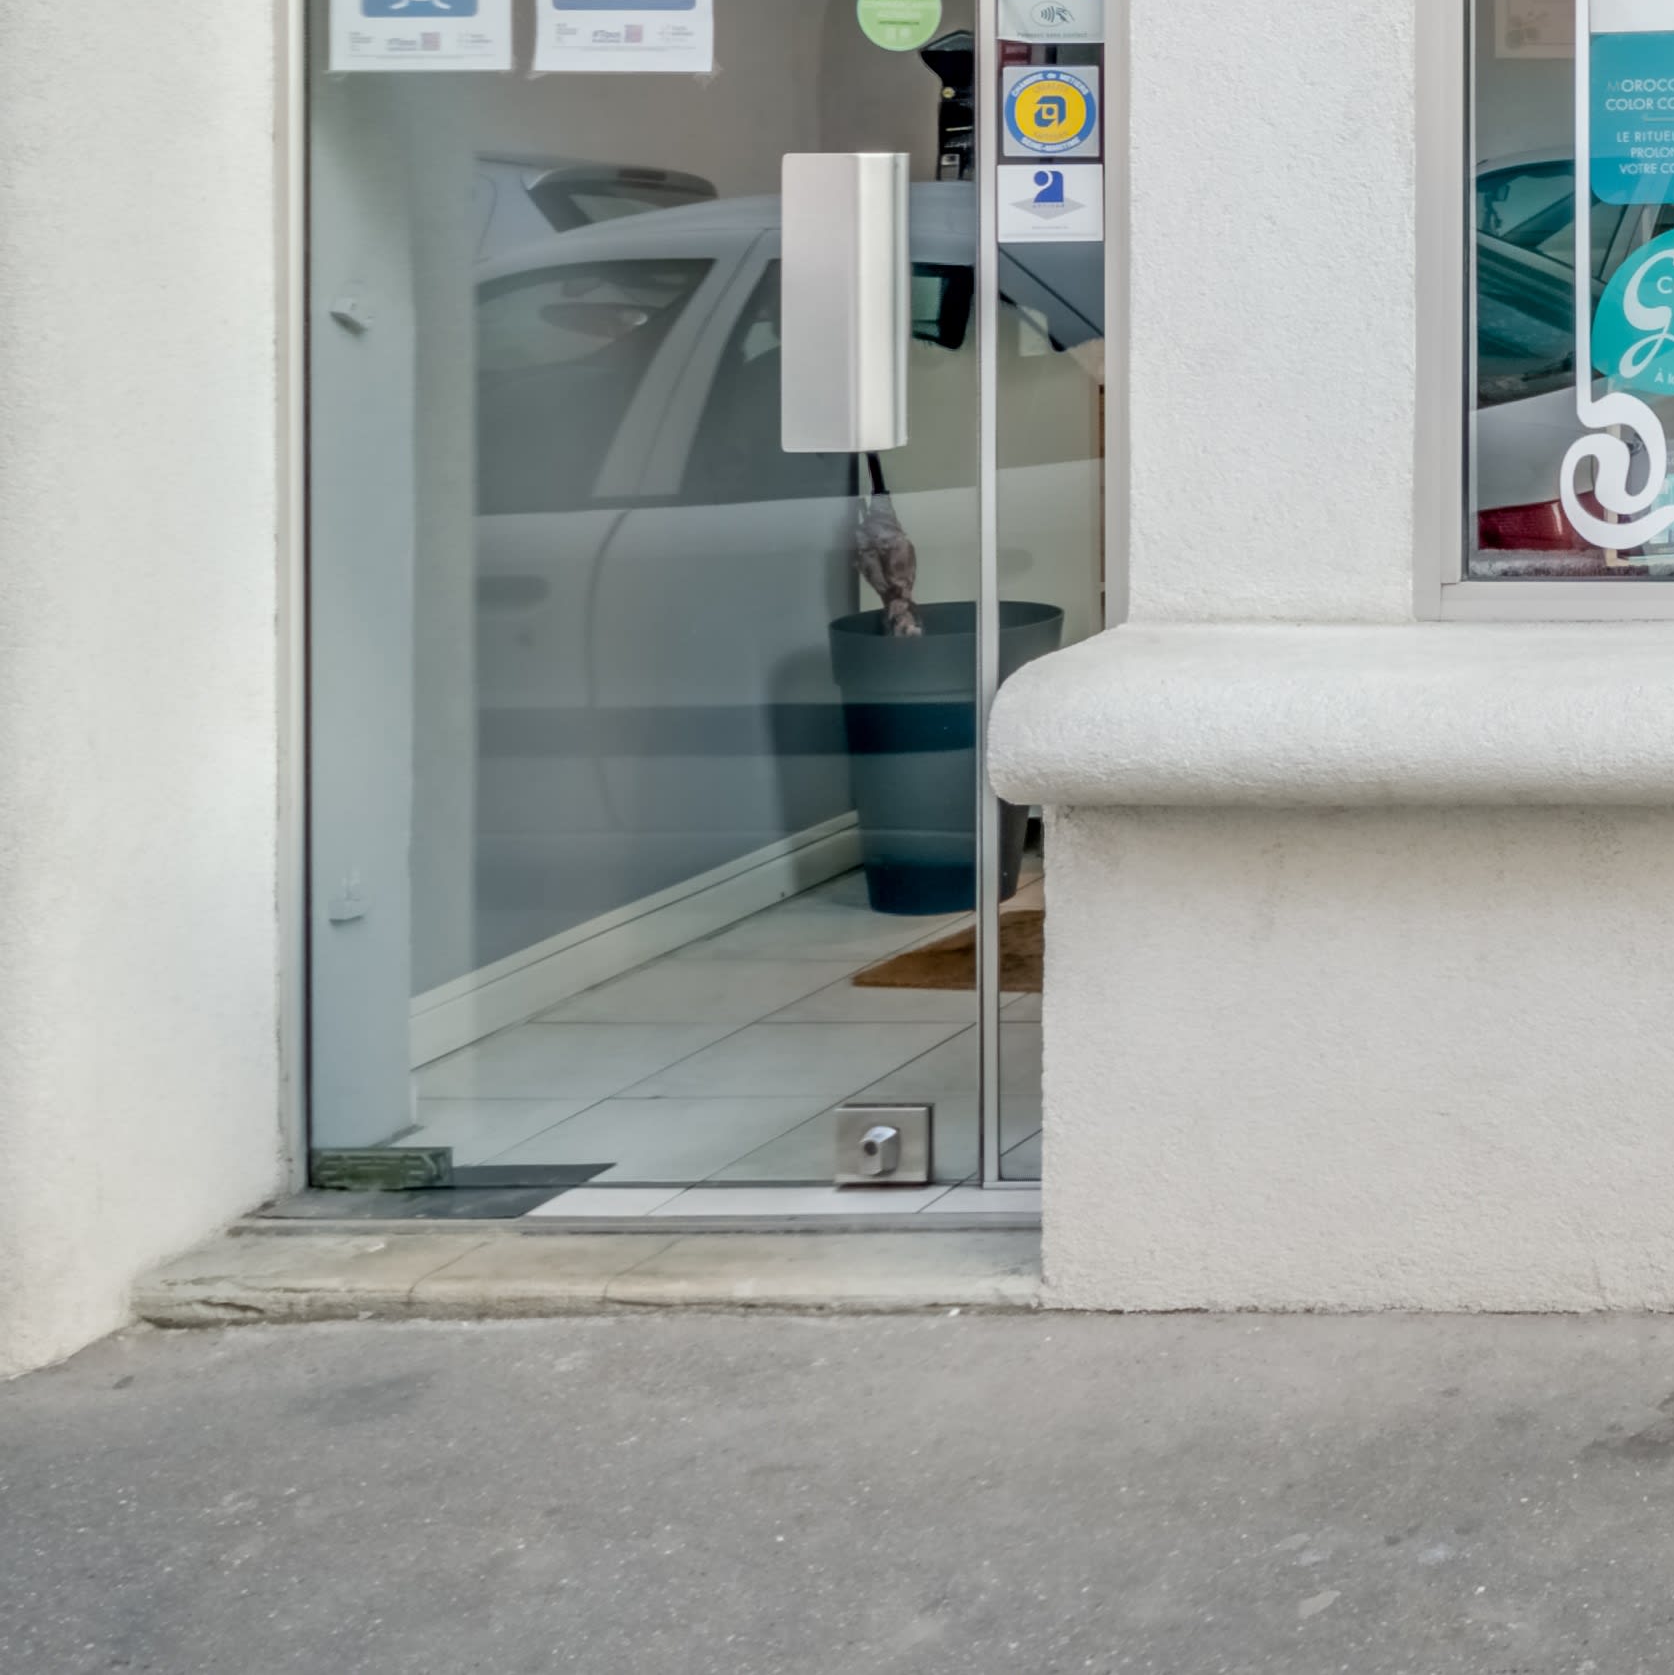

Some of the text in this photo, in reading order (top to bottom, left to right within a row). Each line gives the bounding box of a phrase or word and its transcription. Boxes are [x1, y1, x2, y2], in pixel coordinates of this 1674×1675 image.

[1605, 97, 1654, 111] COLOR
[1616, 131, 1631, 143] LE
[1618, 163, 1657, 175] VOTRE
